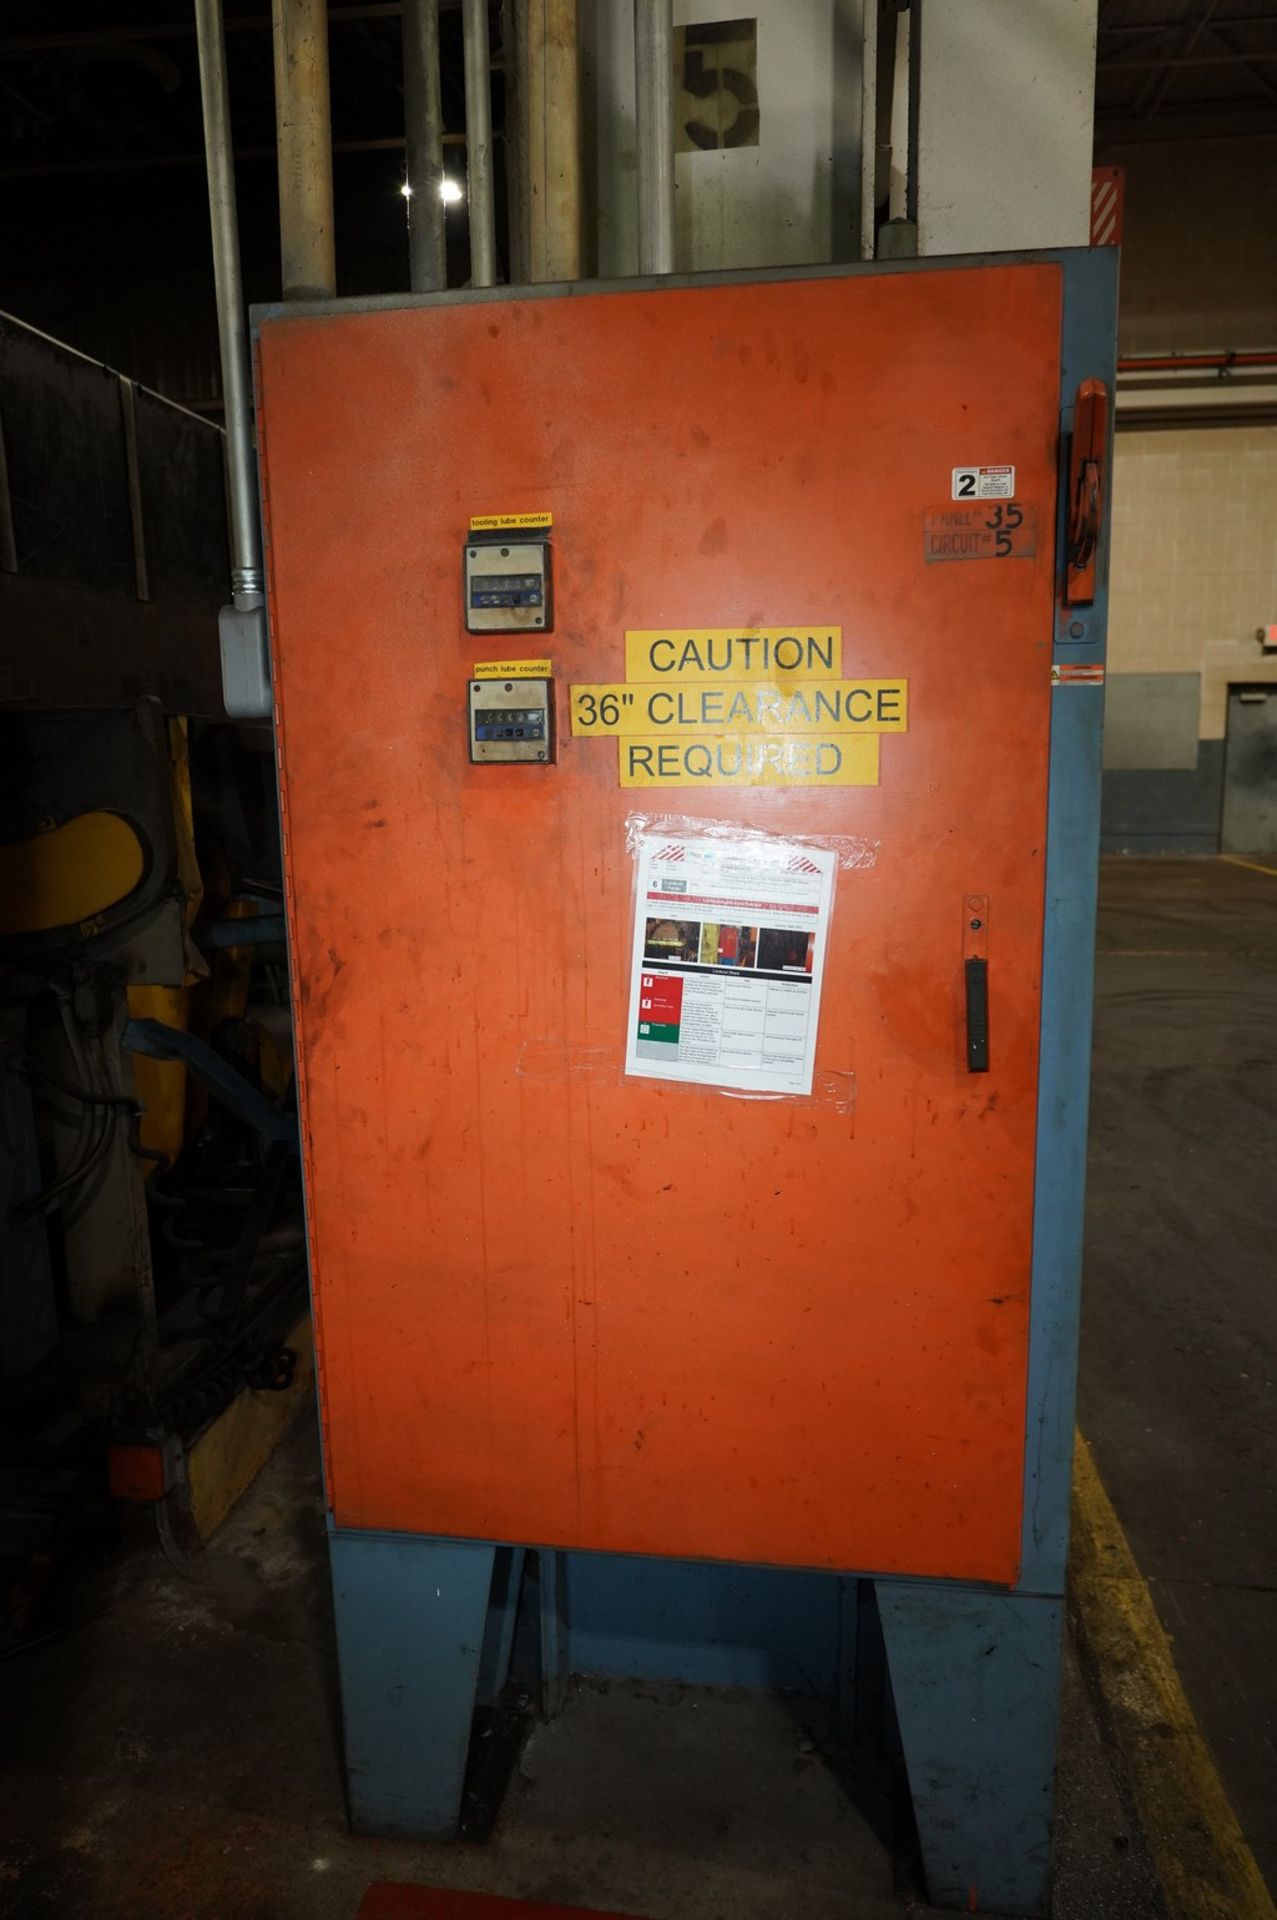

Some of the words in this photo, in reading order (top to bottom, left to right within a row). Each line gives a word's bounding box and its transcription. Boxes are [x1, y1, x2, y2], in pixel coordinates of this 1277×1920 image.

[684, 19, 760, 150] 5
[958, 474, 976, 497] 2
[500, 517, 517, 525] lube
[519, 515, 549, 523] counter
[985, 503, 1024, 530] 35
[995, 530, 1012, 557] 5
[649, 636, 833, 672] CAUTION
[475, 665, 498, 673] punch
[577, 693, 634, 726] 36"
[647, 689, 901, 725] CLEARANCE
[628, 742, 843, 778] REQUIRED
